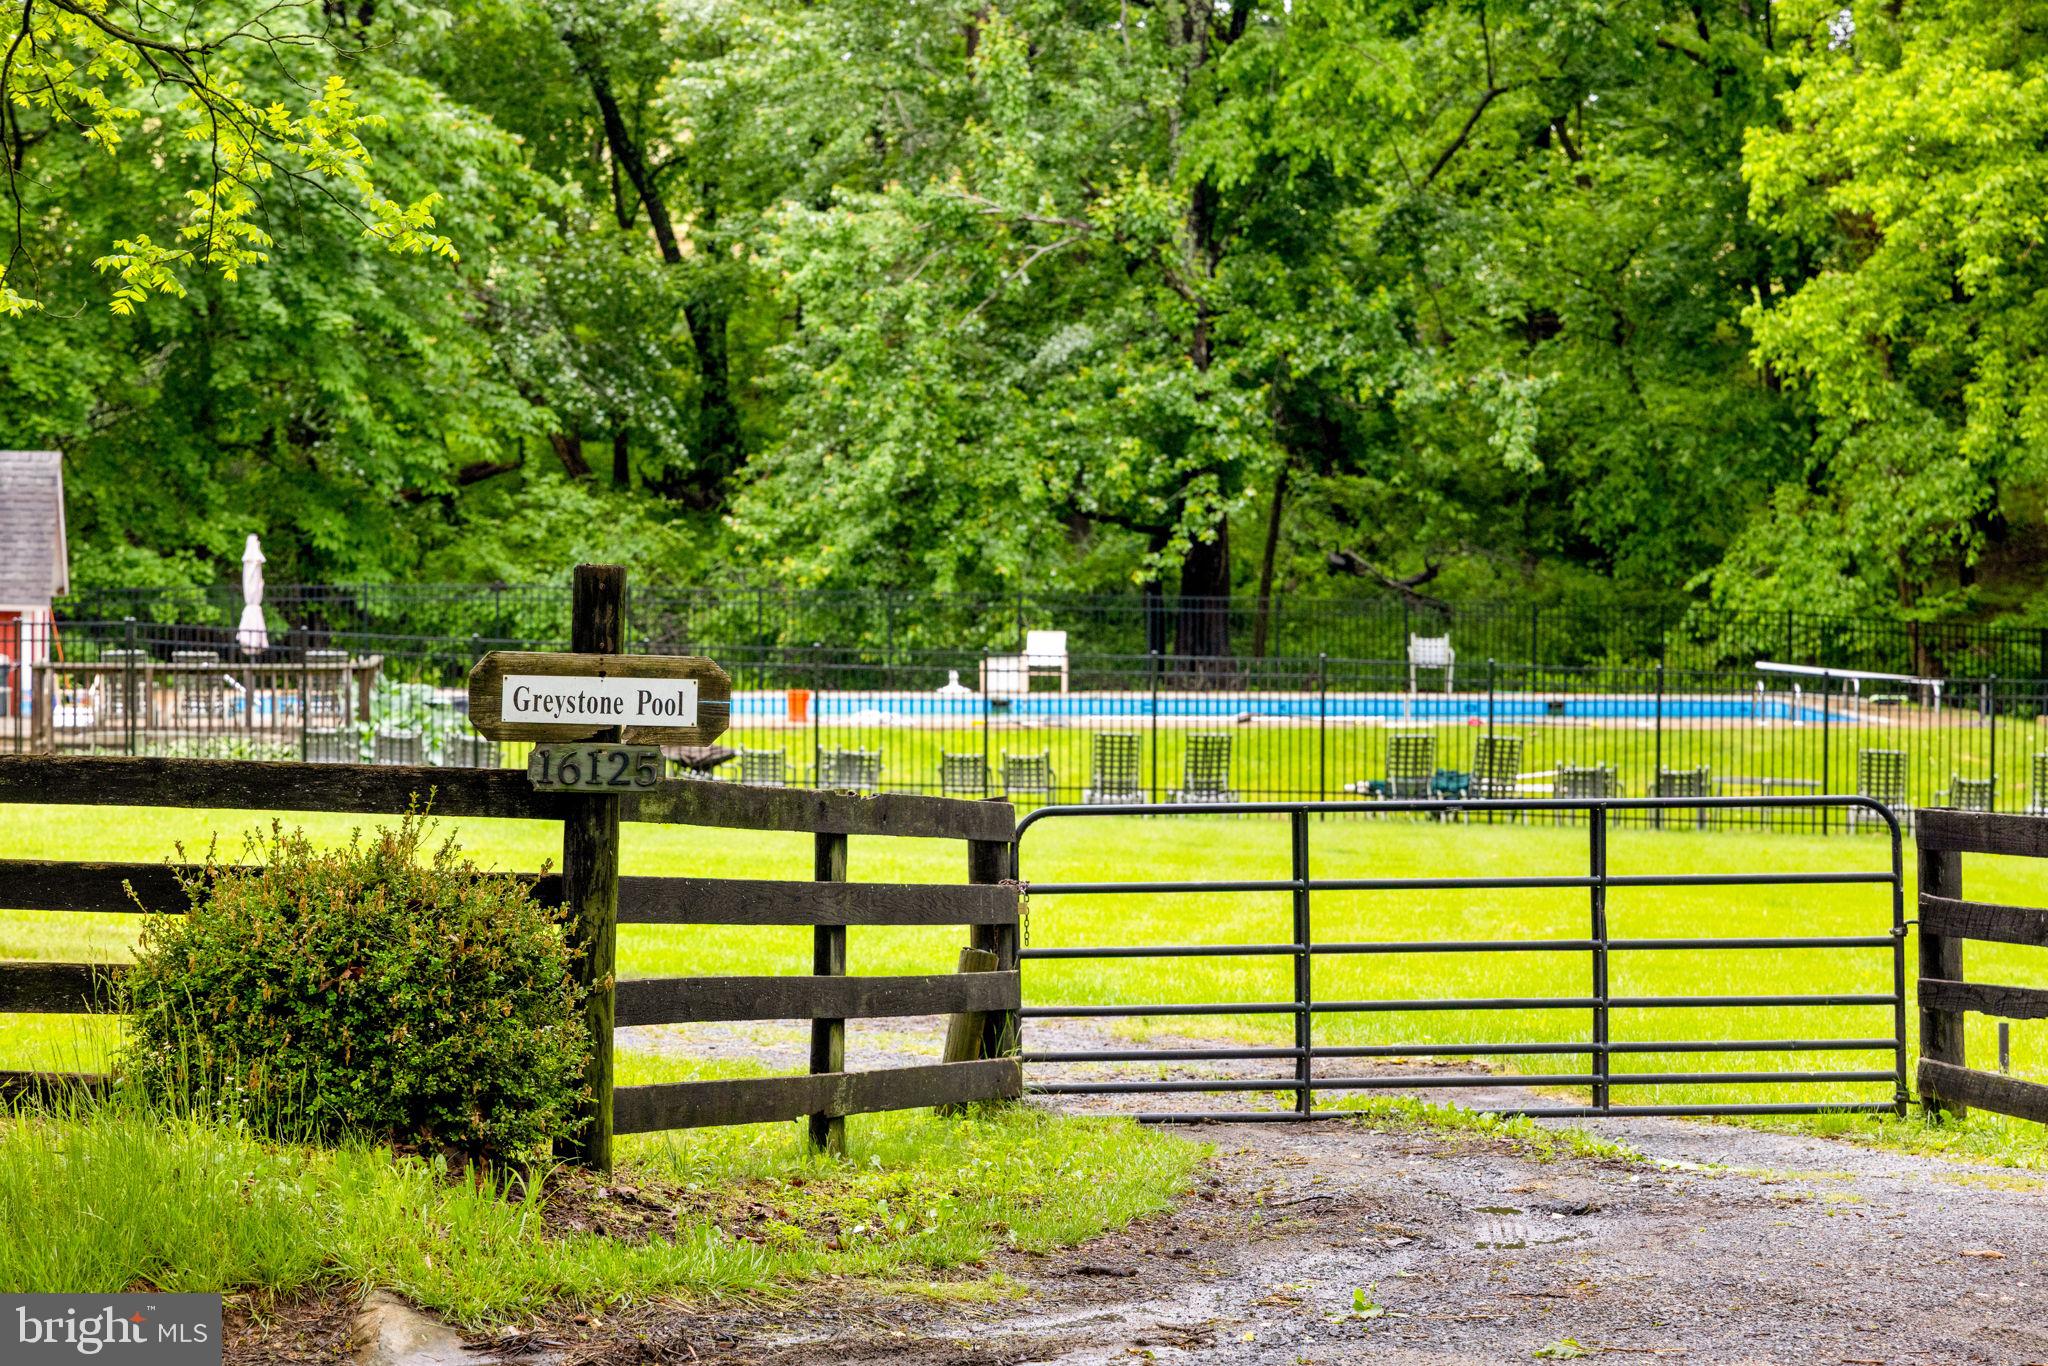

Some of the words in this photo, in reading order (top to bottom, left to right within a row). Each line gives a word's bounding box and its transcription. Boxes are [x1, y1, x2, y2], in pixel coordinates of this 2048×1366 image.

[513, 685, 624, 719] Greystone
[636, 689, 685, 717] Pool
[536, 750, 658, 787] 16125
